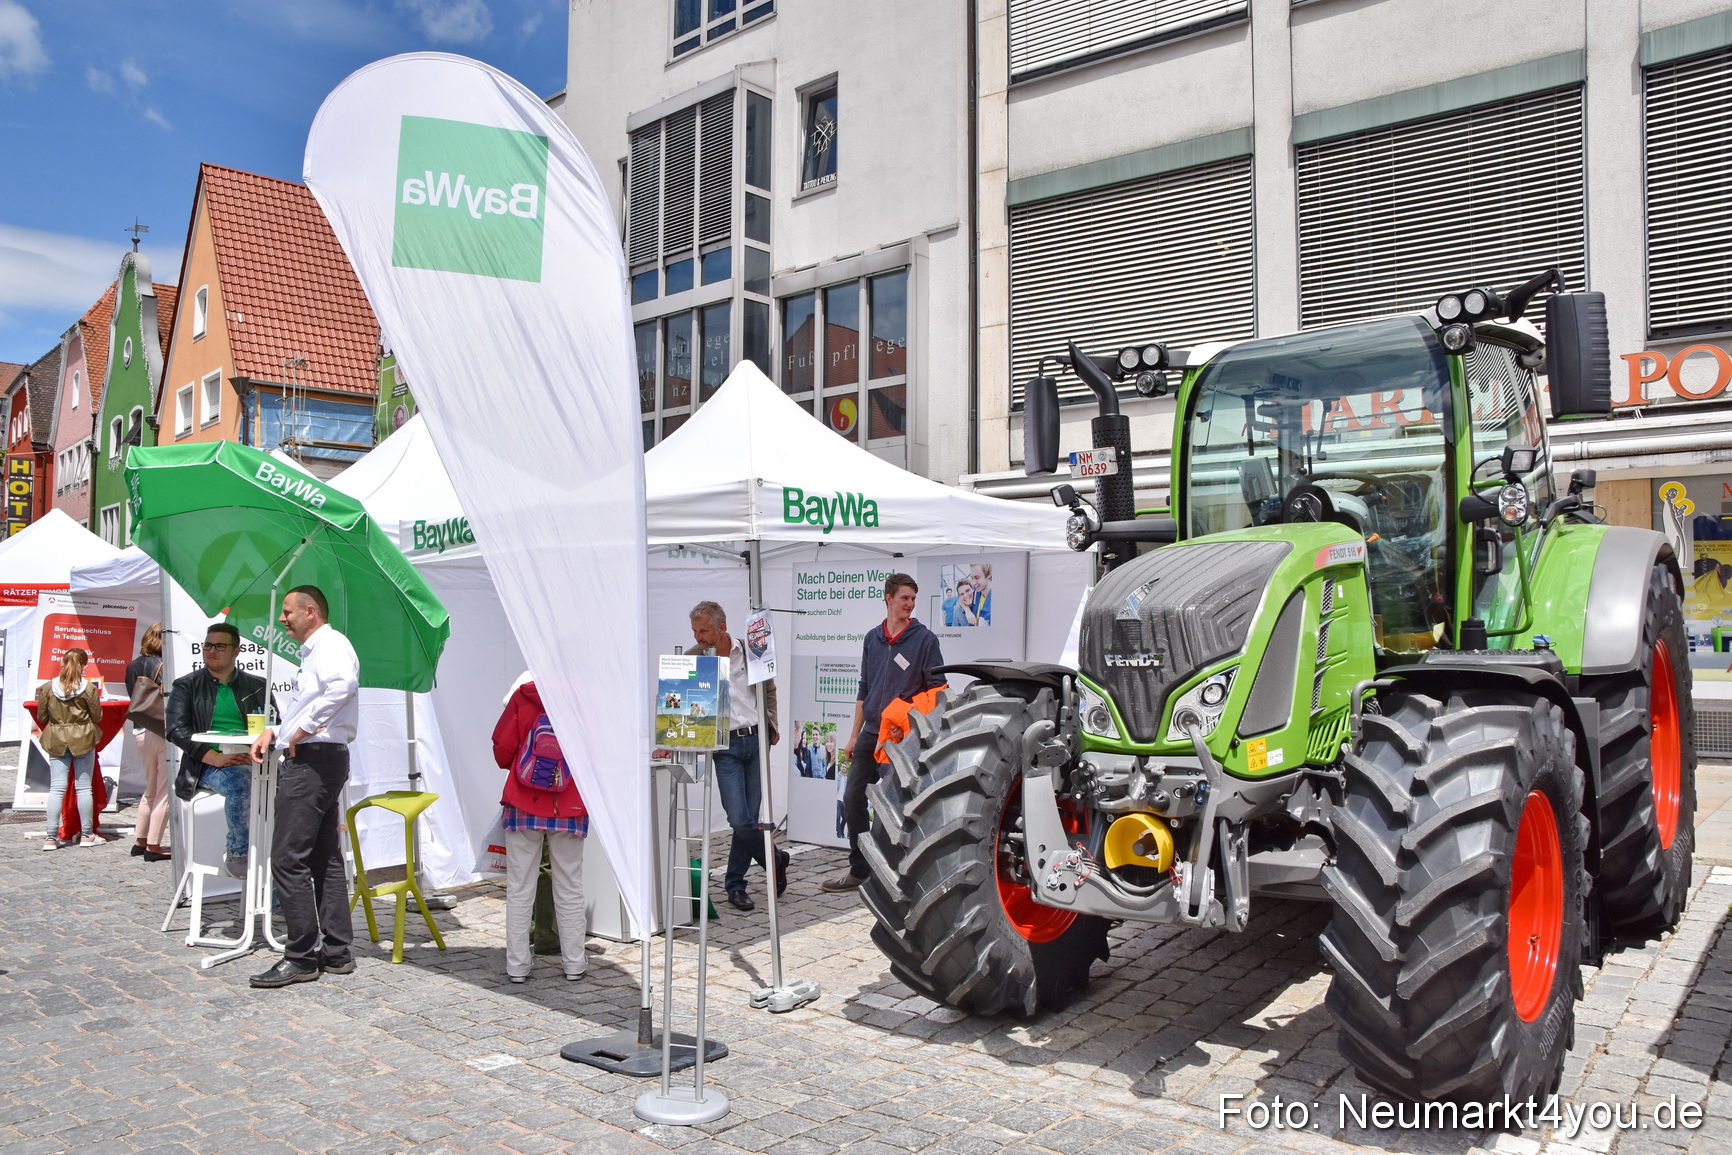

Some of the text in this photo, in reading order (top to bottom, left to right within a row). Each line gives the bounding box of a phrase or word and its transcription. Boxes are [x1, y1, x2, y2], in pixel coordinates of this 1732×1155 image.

[1611, 343, 1732, 407] PO
[1078, 452, 1093, 464] NM
[1080, 462, 1107, 476] 0639
[255, 461, 327, 509] BayWa
[9, 459, 30, 536] HOTE
[782, 486, 879, 534] BayWa
[413, 516, 476, 554] BayWa
[1329, 548, 1347, 560] FENDT
[797, 572, 825, 585] Mach
[828, 571, 864, 584] Deinen
[3, 588, 37, 596] RÄTZER
[797, 586, 886, 601] Starte bei der Bay
[827, 608, 842, 616] Dich!
[54, 626, 112, 635] Berufsabschluss
[796, 633, 826, 642] Ausbildung
[827, 633, 835, 641] bei
[837, 633, 846, 641] der
[1104, 654, 1164, 667] FENDT
[767, 662, 774, 673] 19
[271, 681, 295, 692] Arb
